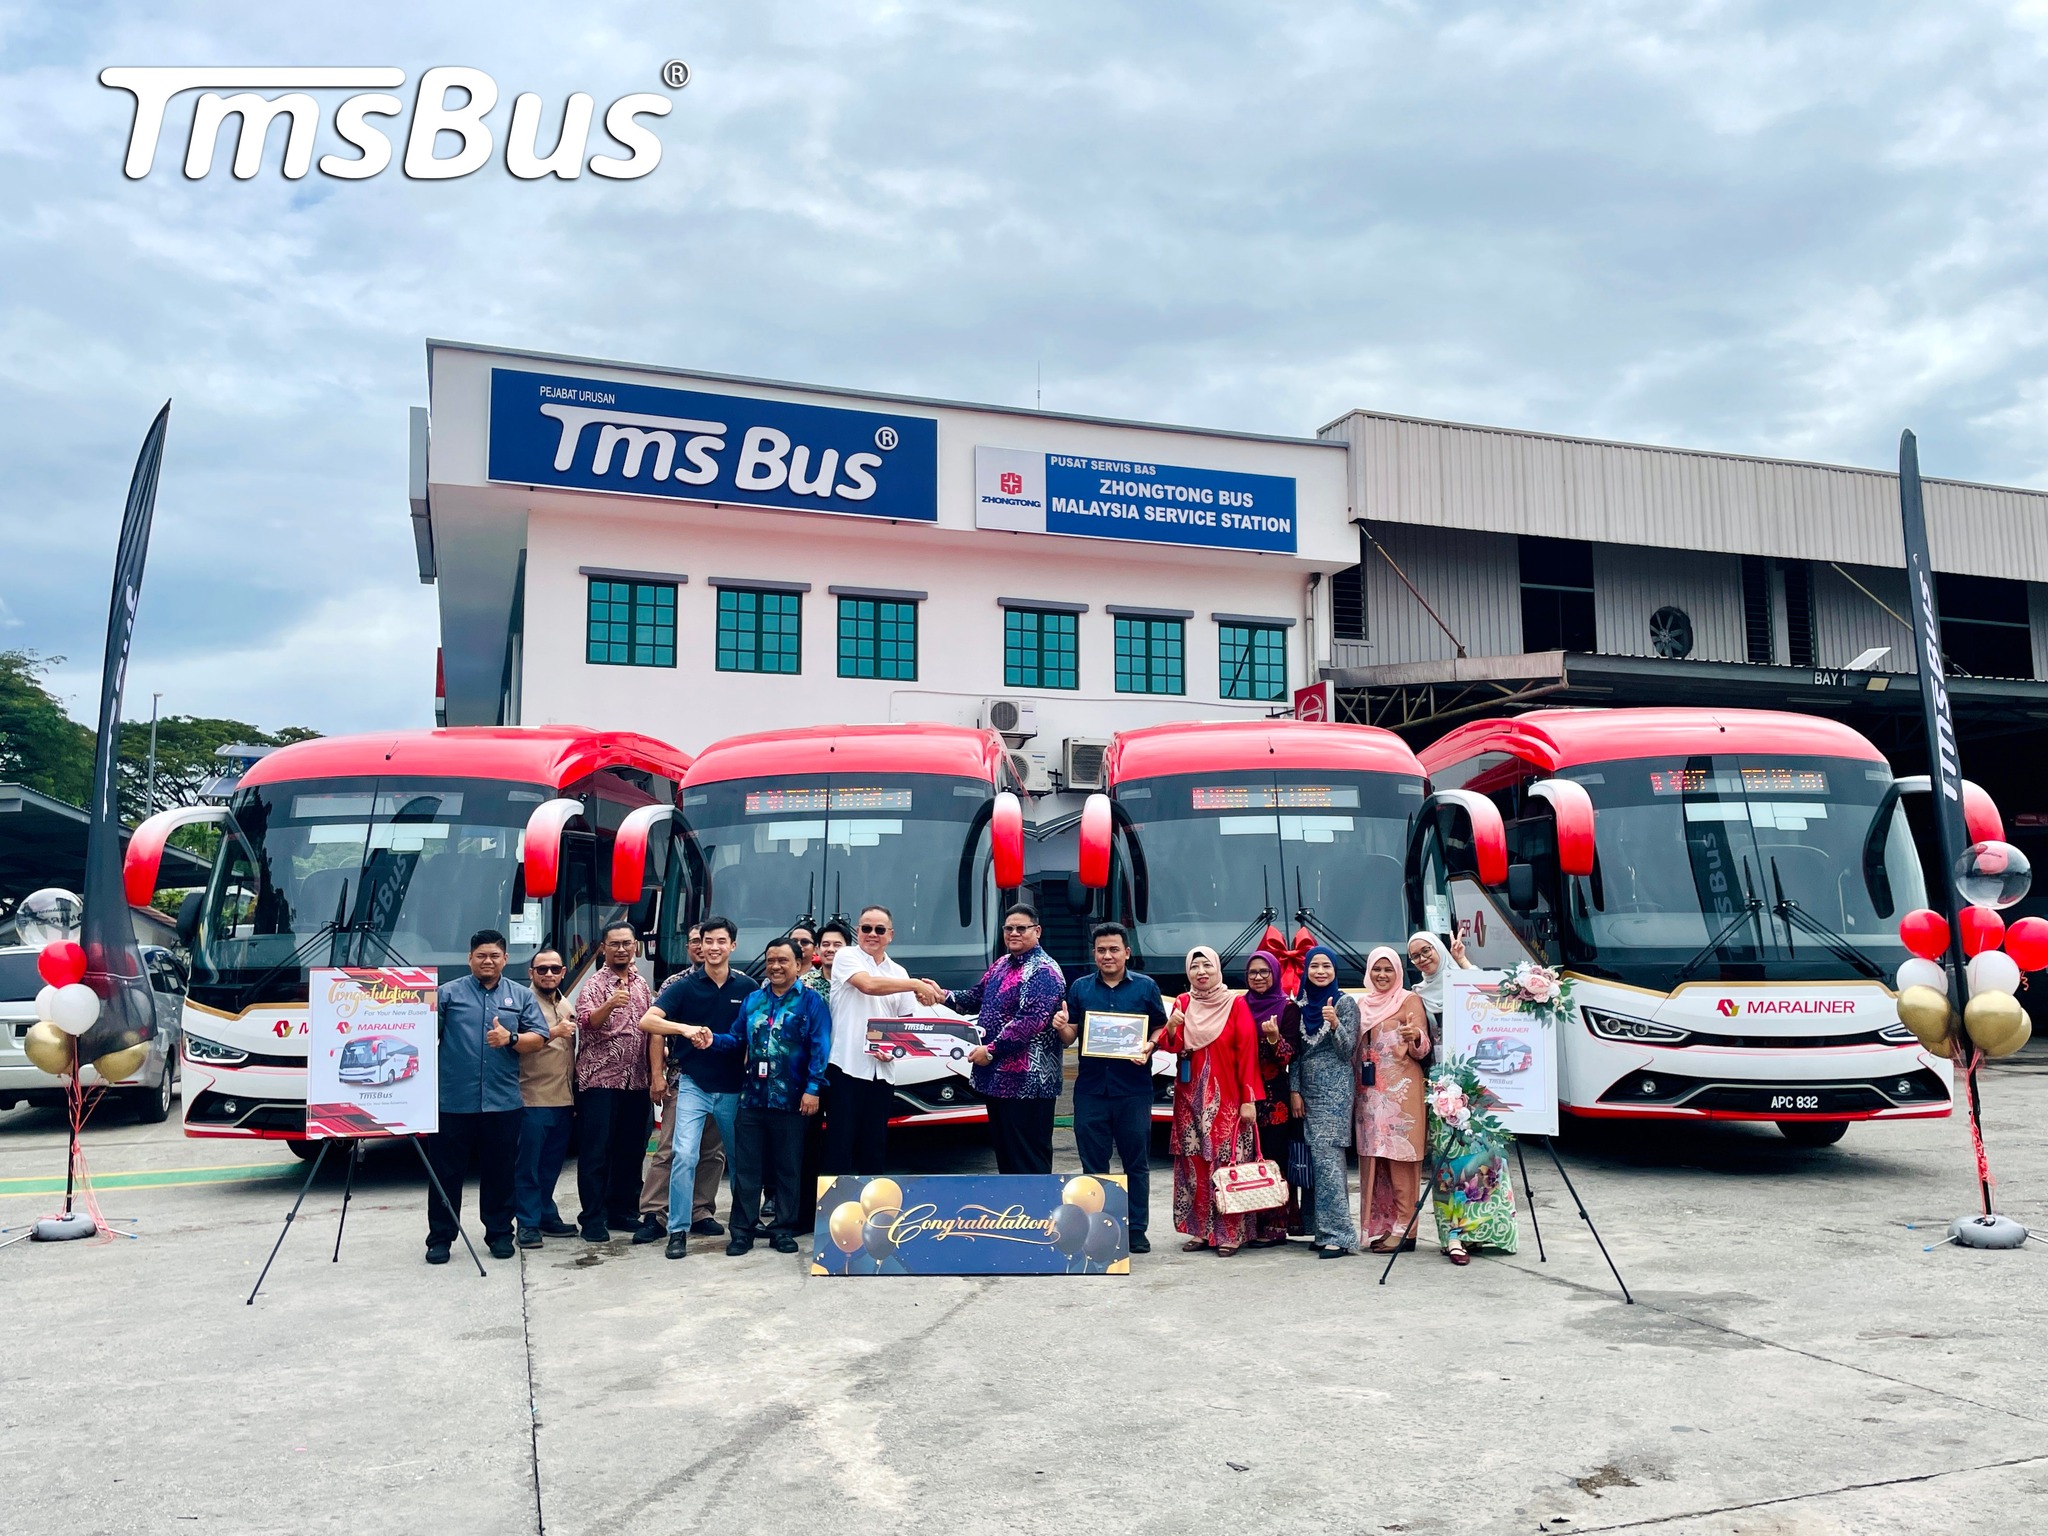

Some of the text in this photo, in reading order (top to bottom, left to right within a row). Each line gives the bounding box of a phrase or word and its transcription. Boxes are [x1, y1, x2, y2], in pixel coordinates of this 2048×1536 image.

[540, 385, 615, 404] PEJABAT URUSAN
[1050, 456, 1156, 475] PUSAT SERVIS BAS
[1099, 479, 1254, 508] ZHONGTONG BUS
[982, 496, 1041, 507] ZHONGTONG
[1052, 497, 1291, 533] MALAYSIA SERVICE STATION
[1814, 671, 1848, 686] BAY 1
[328, 977, 421, 1018] Congratulations
[1747, 1000, 1855, 1014] MARALINER
[357, 1023, 416, 1031] MARALINER
[359, 1092, 393, 1100] TmsBus
[1771, 1095, 1818, 1109] APC 832
